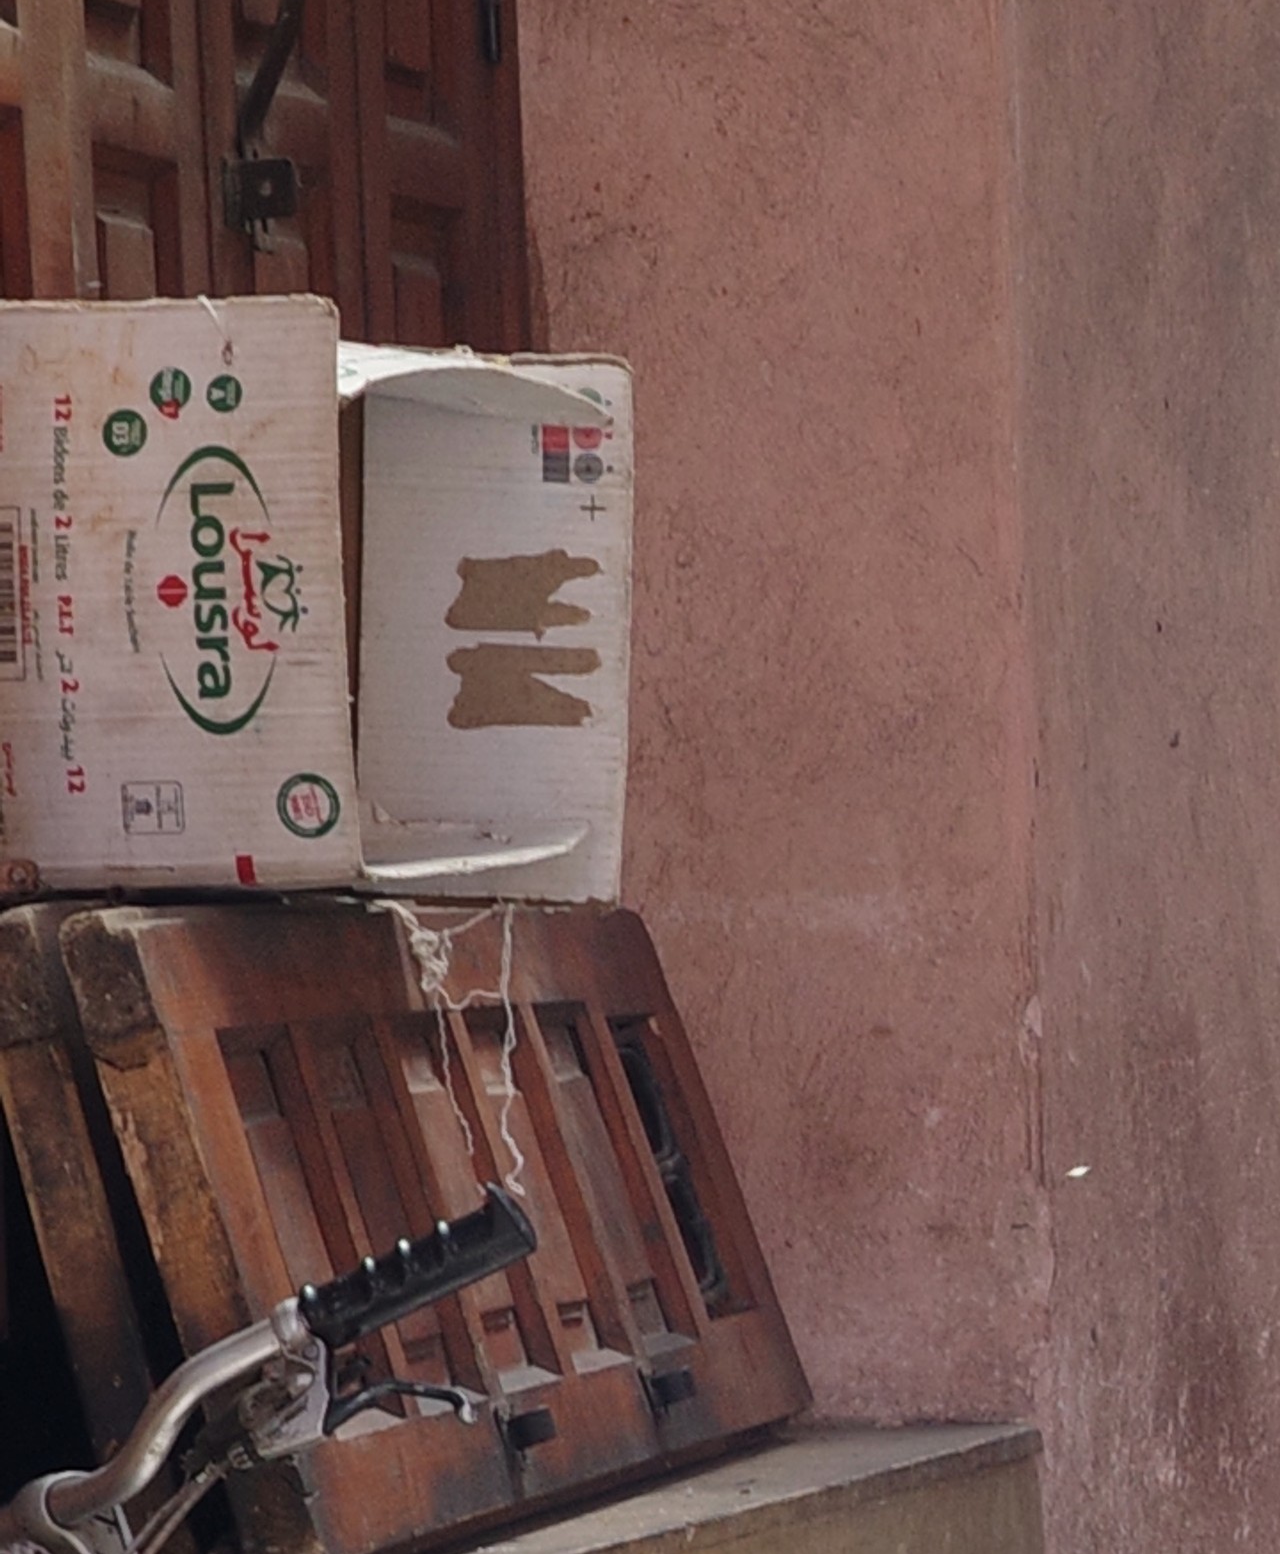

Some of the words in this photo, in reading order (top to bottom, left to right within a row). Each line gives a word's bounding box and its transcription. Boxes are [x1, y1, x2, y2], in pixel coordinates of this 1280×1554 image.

[54, 394, 72, 422] 12
[112, 420, 129, 446] D3
[53, 425, 70, 485] Bidons
[53, 488, 70, 512] de
[54, 515, 73, 530] 2
[54, 534, 70, 581] Litres
[190, 480, 235, 700] Lousra
[229, 528, 280, 651] لوسرا
[61, 678, 79, 694] 2
[66, 764, 86, 795] 12
